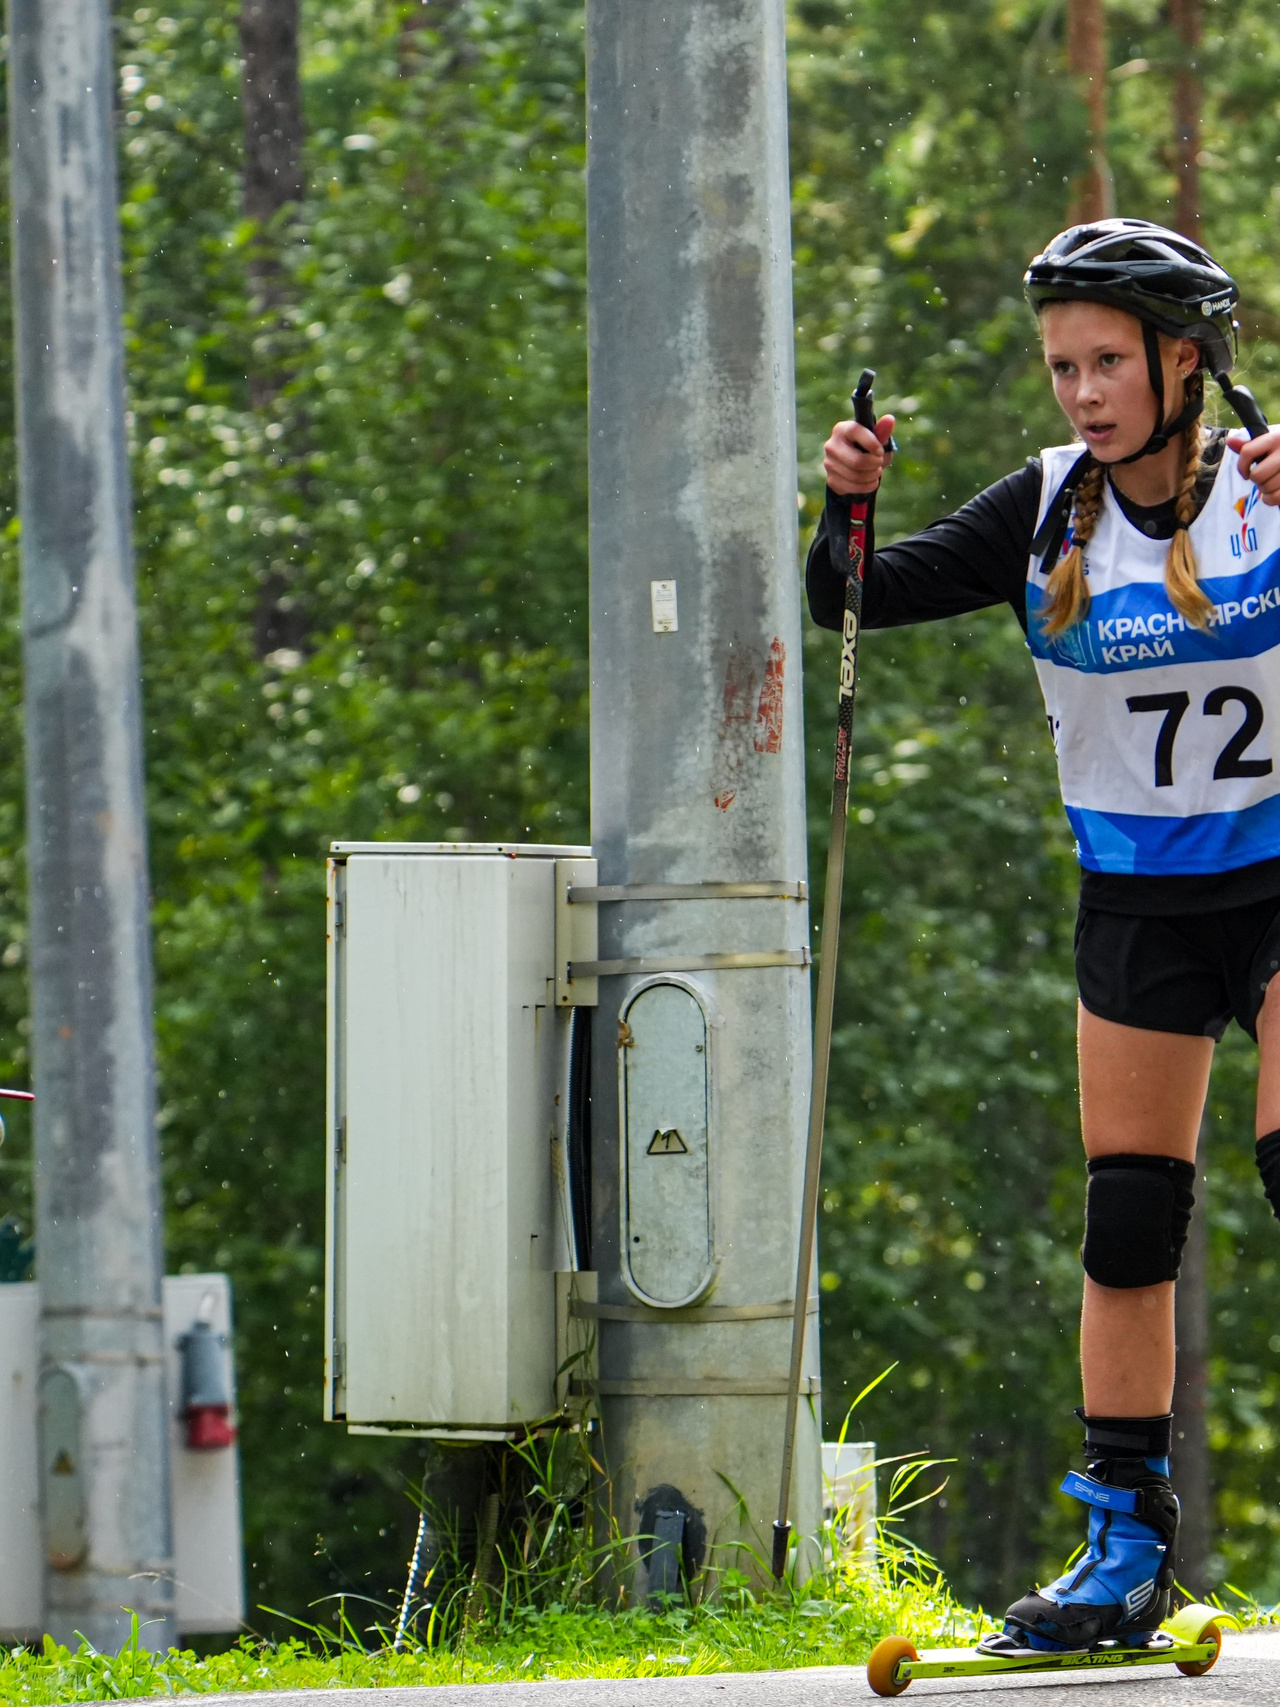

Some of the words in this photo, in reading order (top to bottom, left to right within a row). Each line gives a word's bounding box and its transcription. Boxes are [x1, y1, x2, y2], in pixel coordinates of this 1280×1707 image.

[1102, 635, 1175, 665] КРАЙ
[1125, 685, 1273, 787] 72
[1074, 1481, 1110, 1503] SPINE
[1060, 1653, 1124, 1667] SKATING
